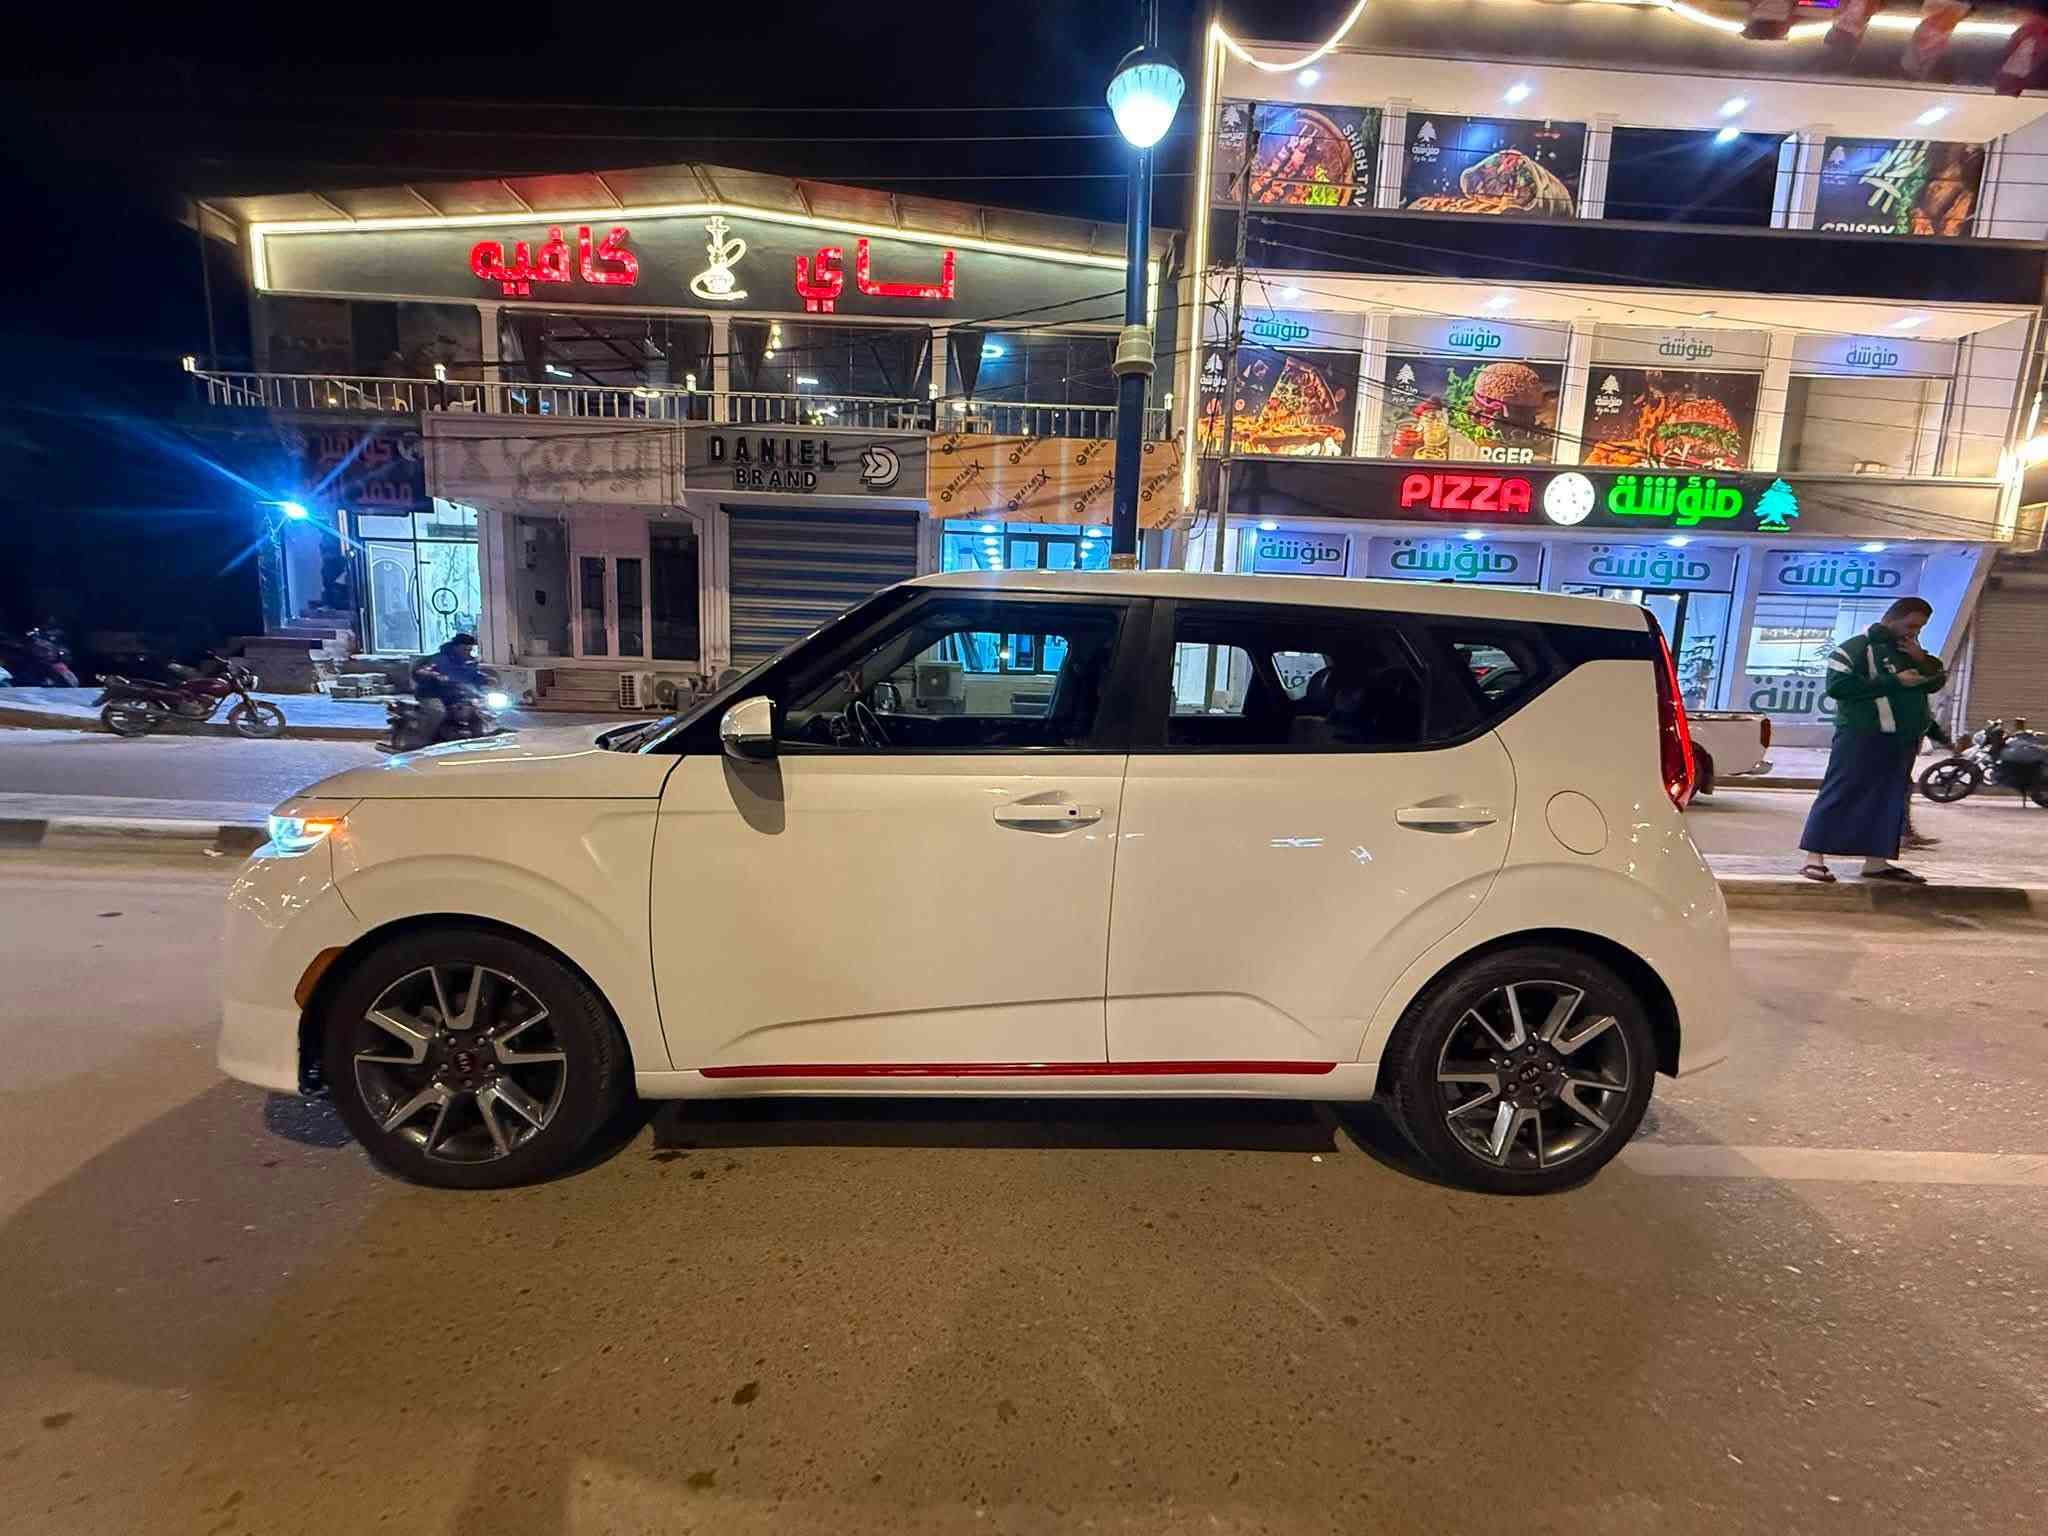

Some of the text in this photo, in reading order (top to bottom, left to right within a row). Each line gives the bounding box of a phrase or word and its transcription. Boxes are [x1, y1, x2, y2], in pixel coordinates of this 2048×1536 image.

[1342, 124, 1369, 171] SHISH
[470, 225, 639, 296] كافيه
[709, 436, 835, 467] DANIEL
[734, 468, 817, 490] BRAND
[1400, 473, 1532, 513] PIZZA
[1608, 475, 1743, 526] منؤشة
